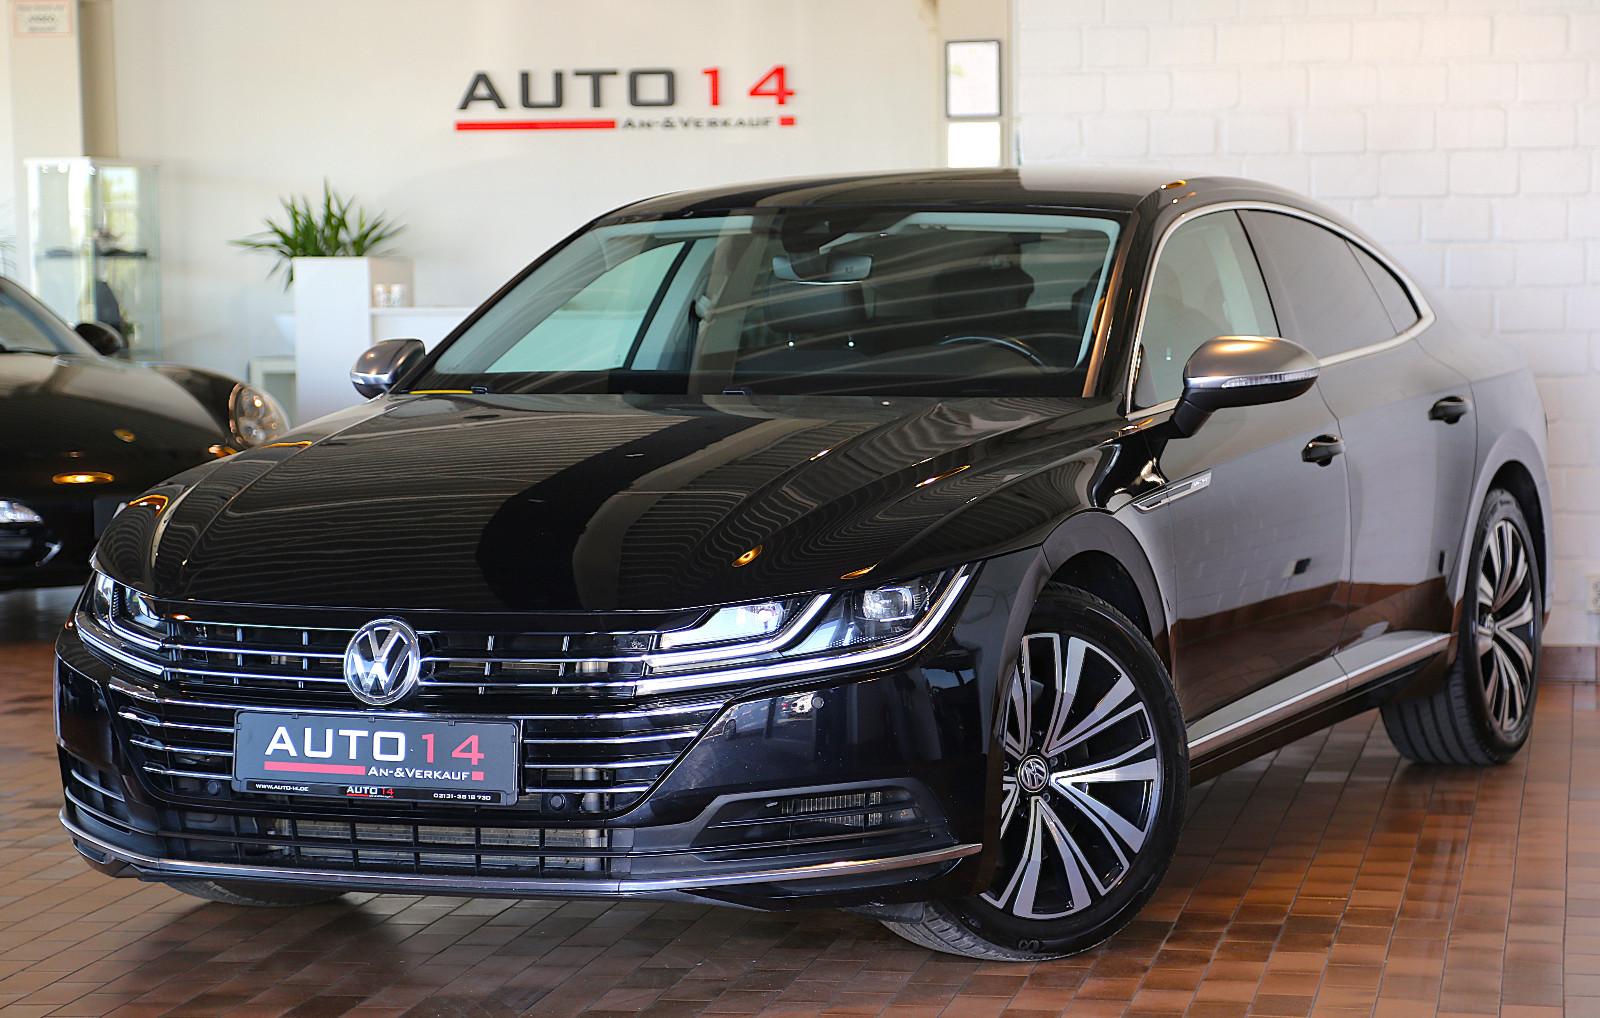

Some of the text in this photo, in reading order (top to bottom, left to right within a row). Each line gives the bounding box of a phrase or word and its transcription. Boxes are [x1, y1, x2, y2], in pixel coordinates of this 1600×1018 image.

[458, 65, 796, 110] AUTO 14
[264, 726, 485, 766] AUTO 14
[346, 785, 395, 796] AUTO 14
